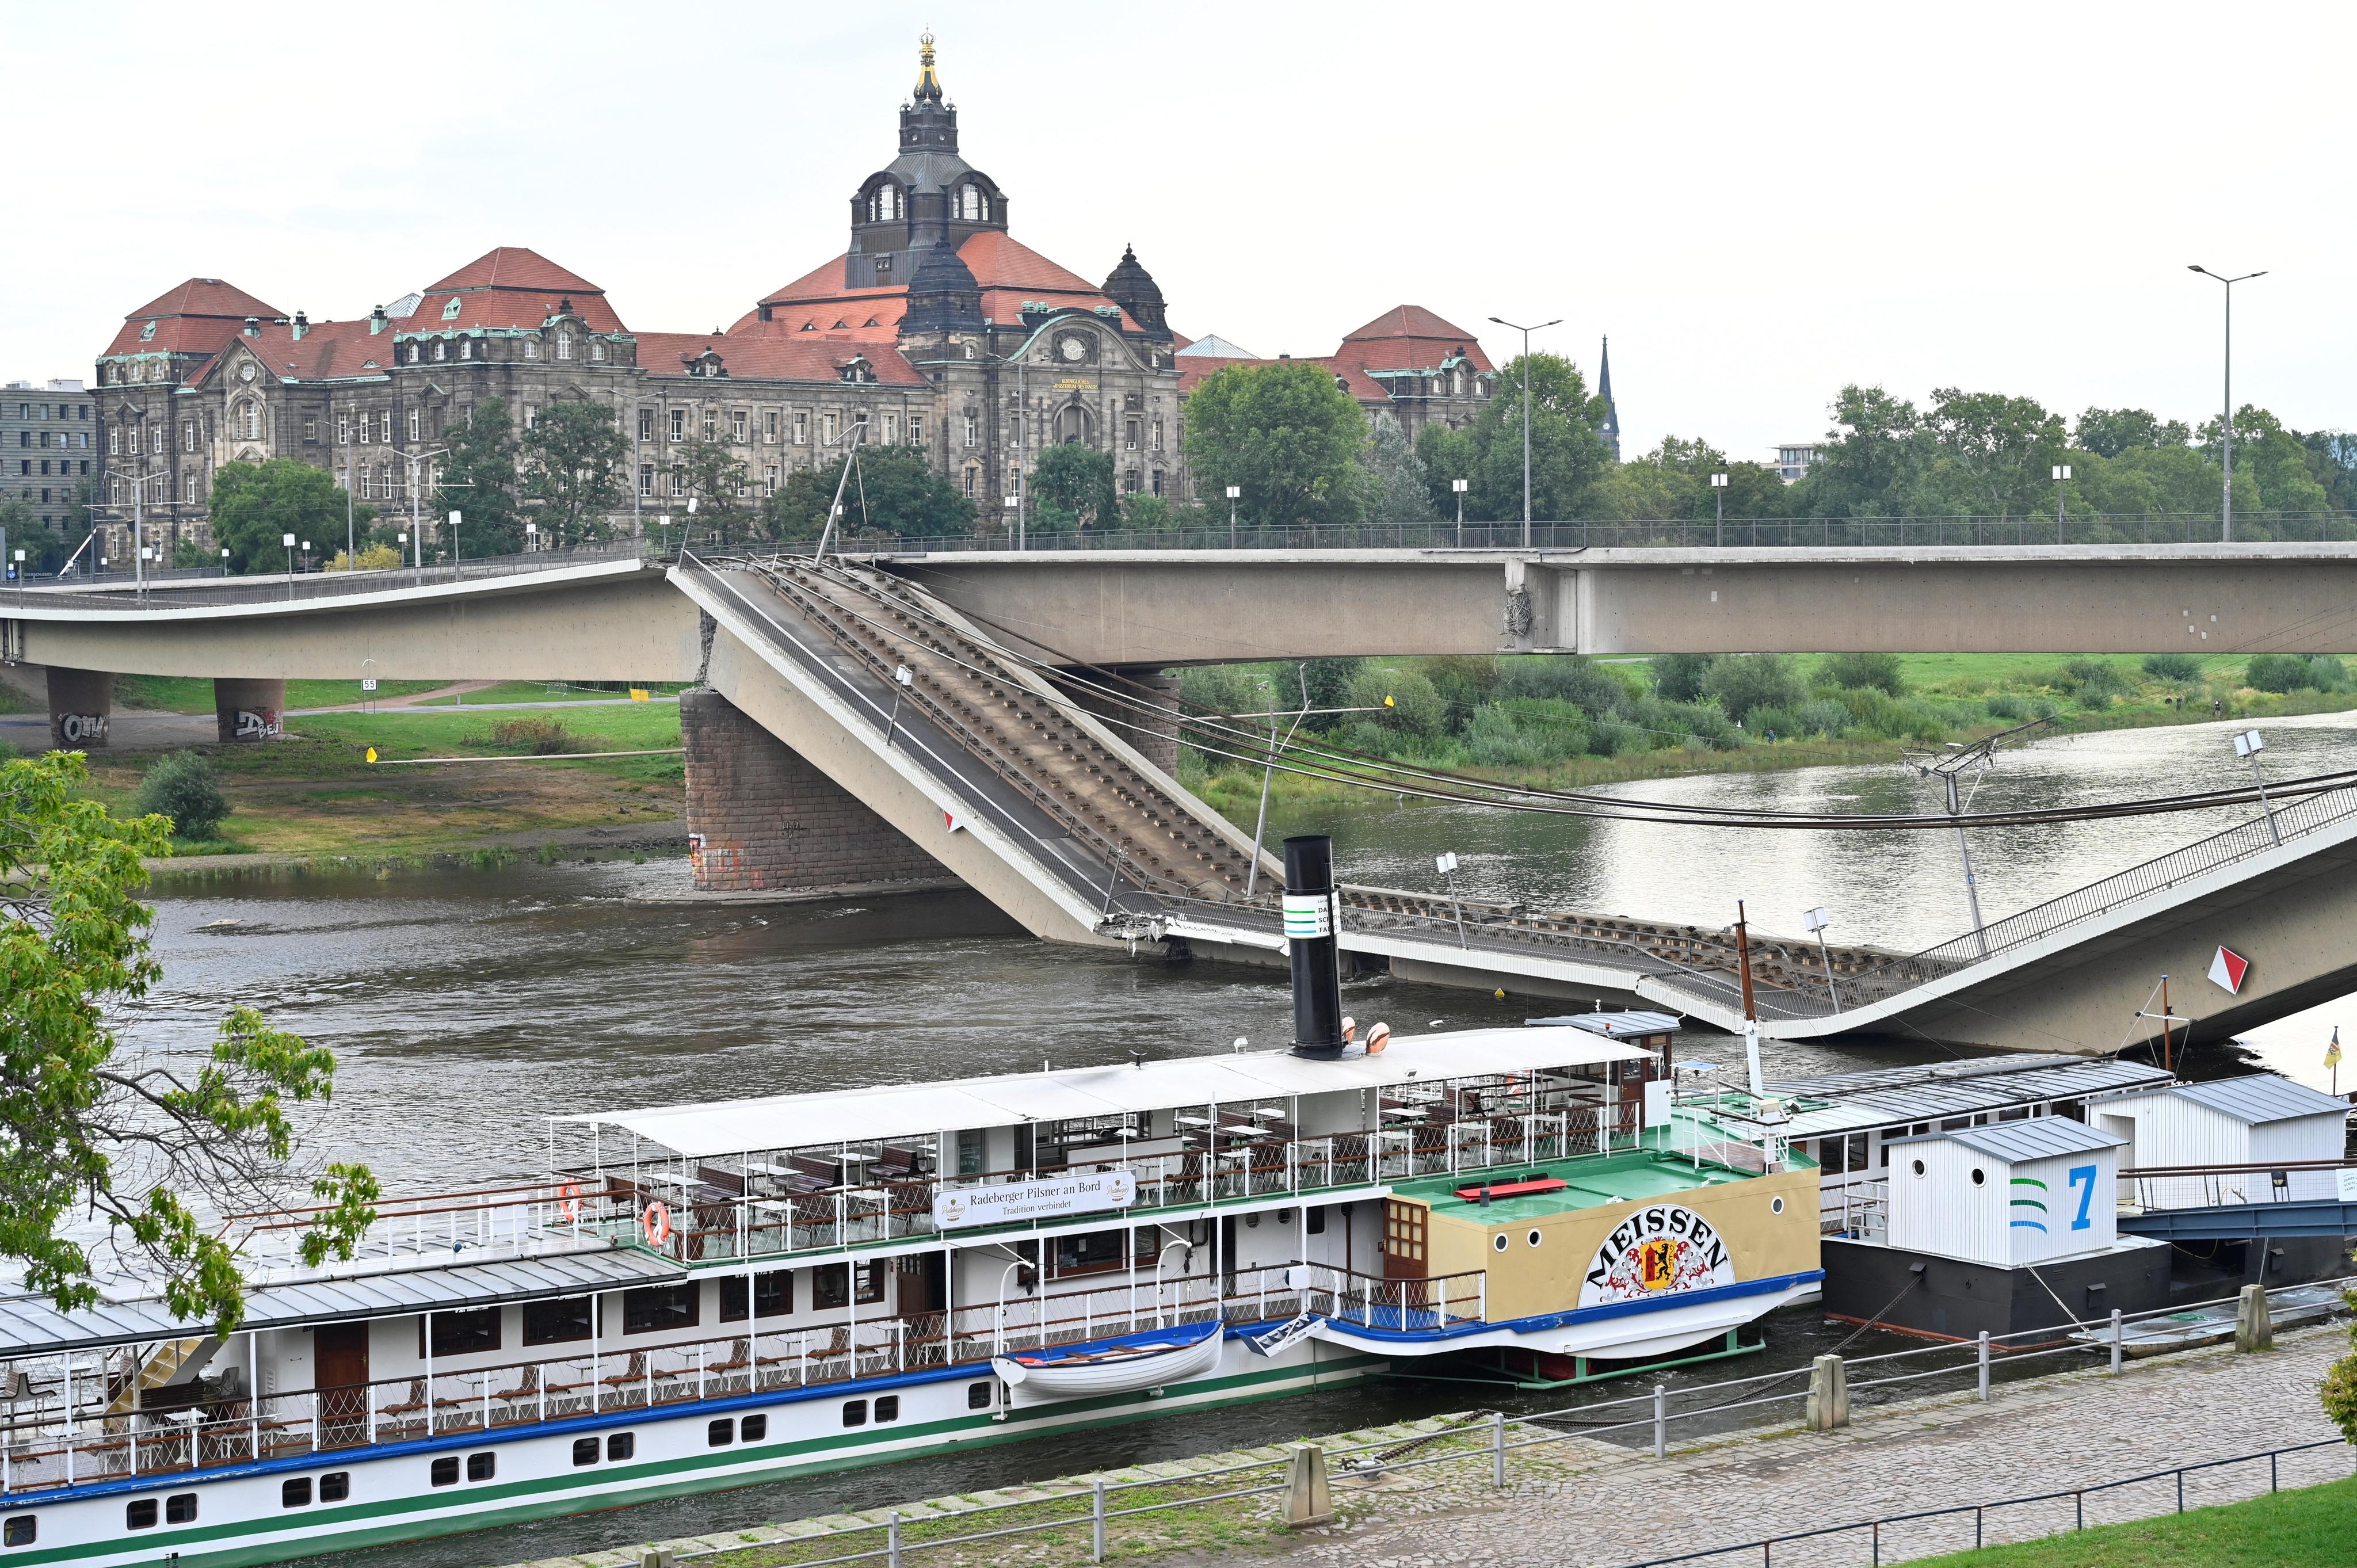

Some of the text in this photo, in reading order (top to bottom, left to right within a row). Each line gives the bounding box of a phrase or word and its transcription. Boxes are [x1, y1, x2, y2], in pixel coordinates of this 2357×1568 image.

[971, 1180, 1100, 1206] Radeberger Pilsner an Bord
[1002, 1200, 1071, 1215] Tradition verbindet
[2069, 1164, 2096, 1231] 7
[1586, 1208, 1727, 1290] MEISSEN
